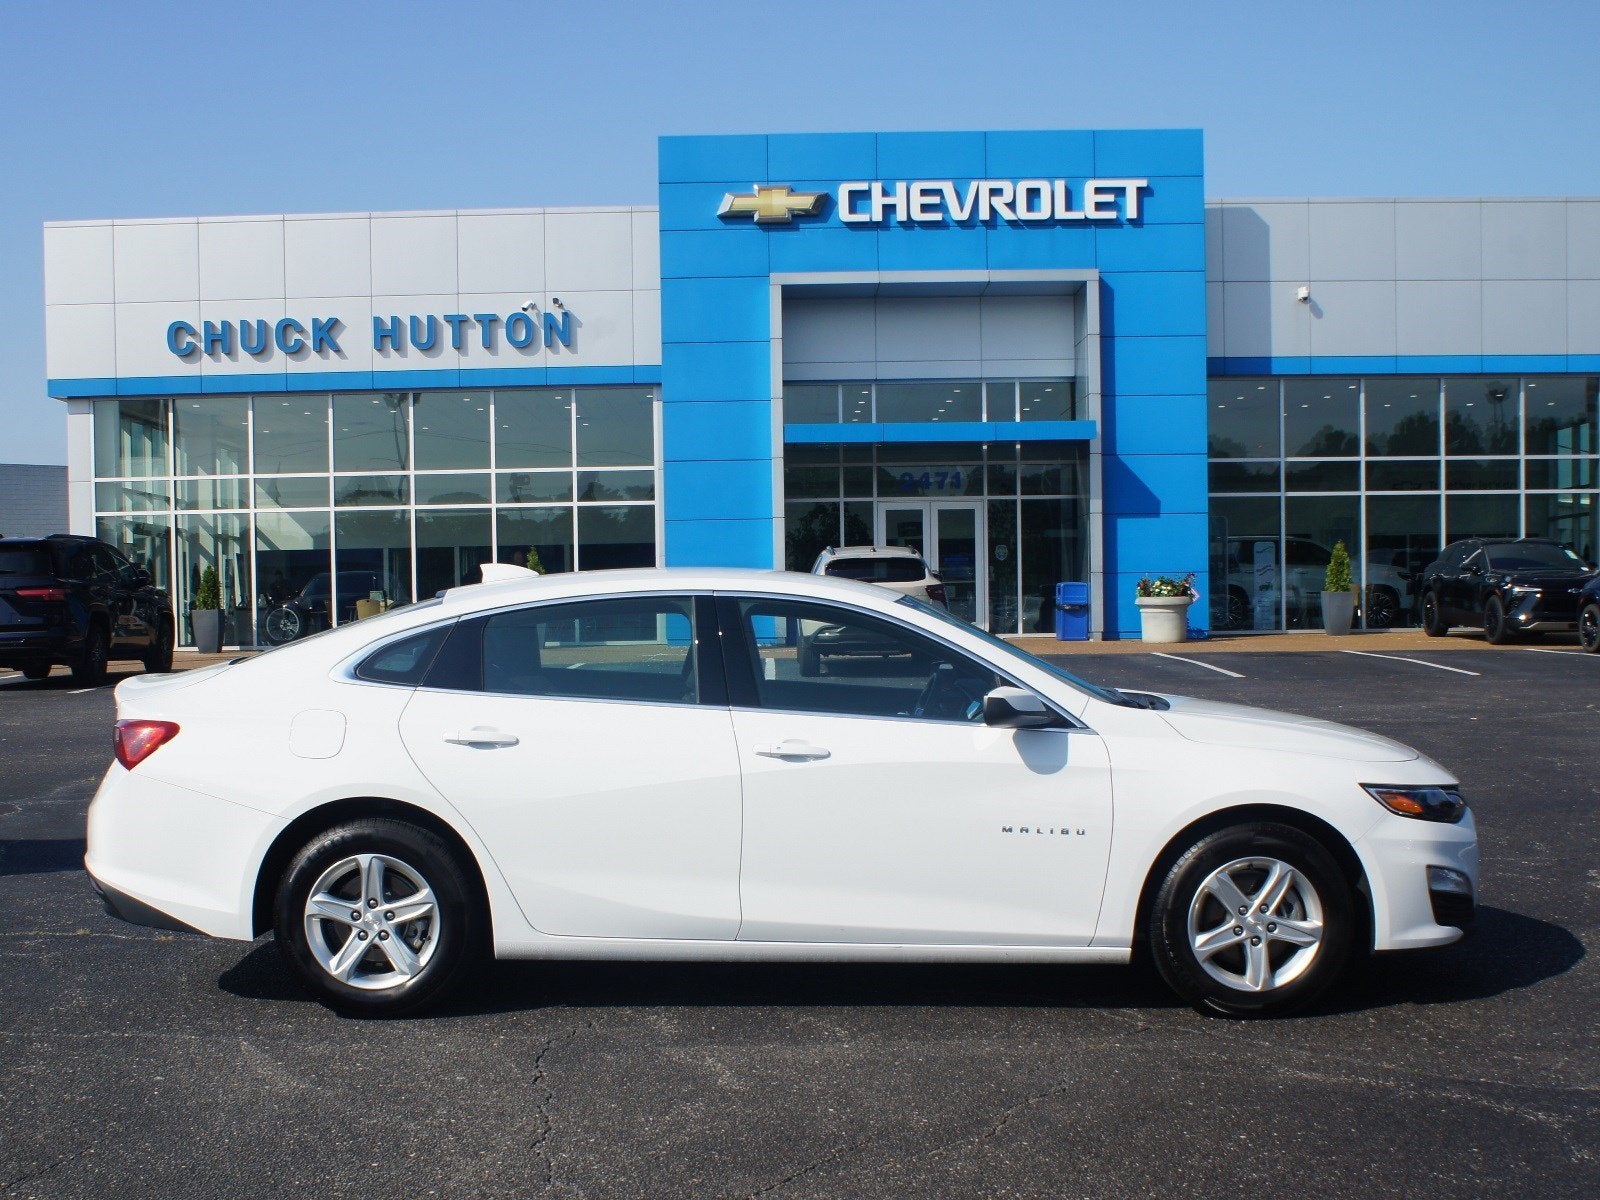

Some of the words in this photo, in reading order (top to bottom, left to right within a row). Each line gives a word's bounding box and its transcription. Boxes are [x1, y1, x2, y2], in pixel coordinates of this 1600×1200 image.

[837, 179, 1148, 222] CHEVROLET
[166, 317, 341, 357] CHUCK
[372, 312, 572, 351] HUTTON
[900, 471, 962, 490] 2471
[1001, 825, 1086, 836] MALIBU
